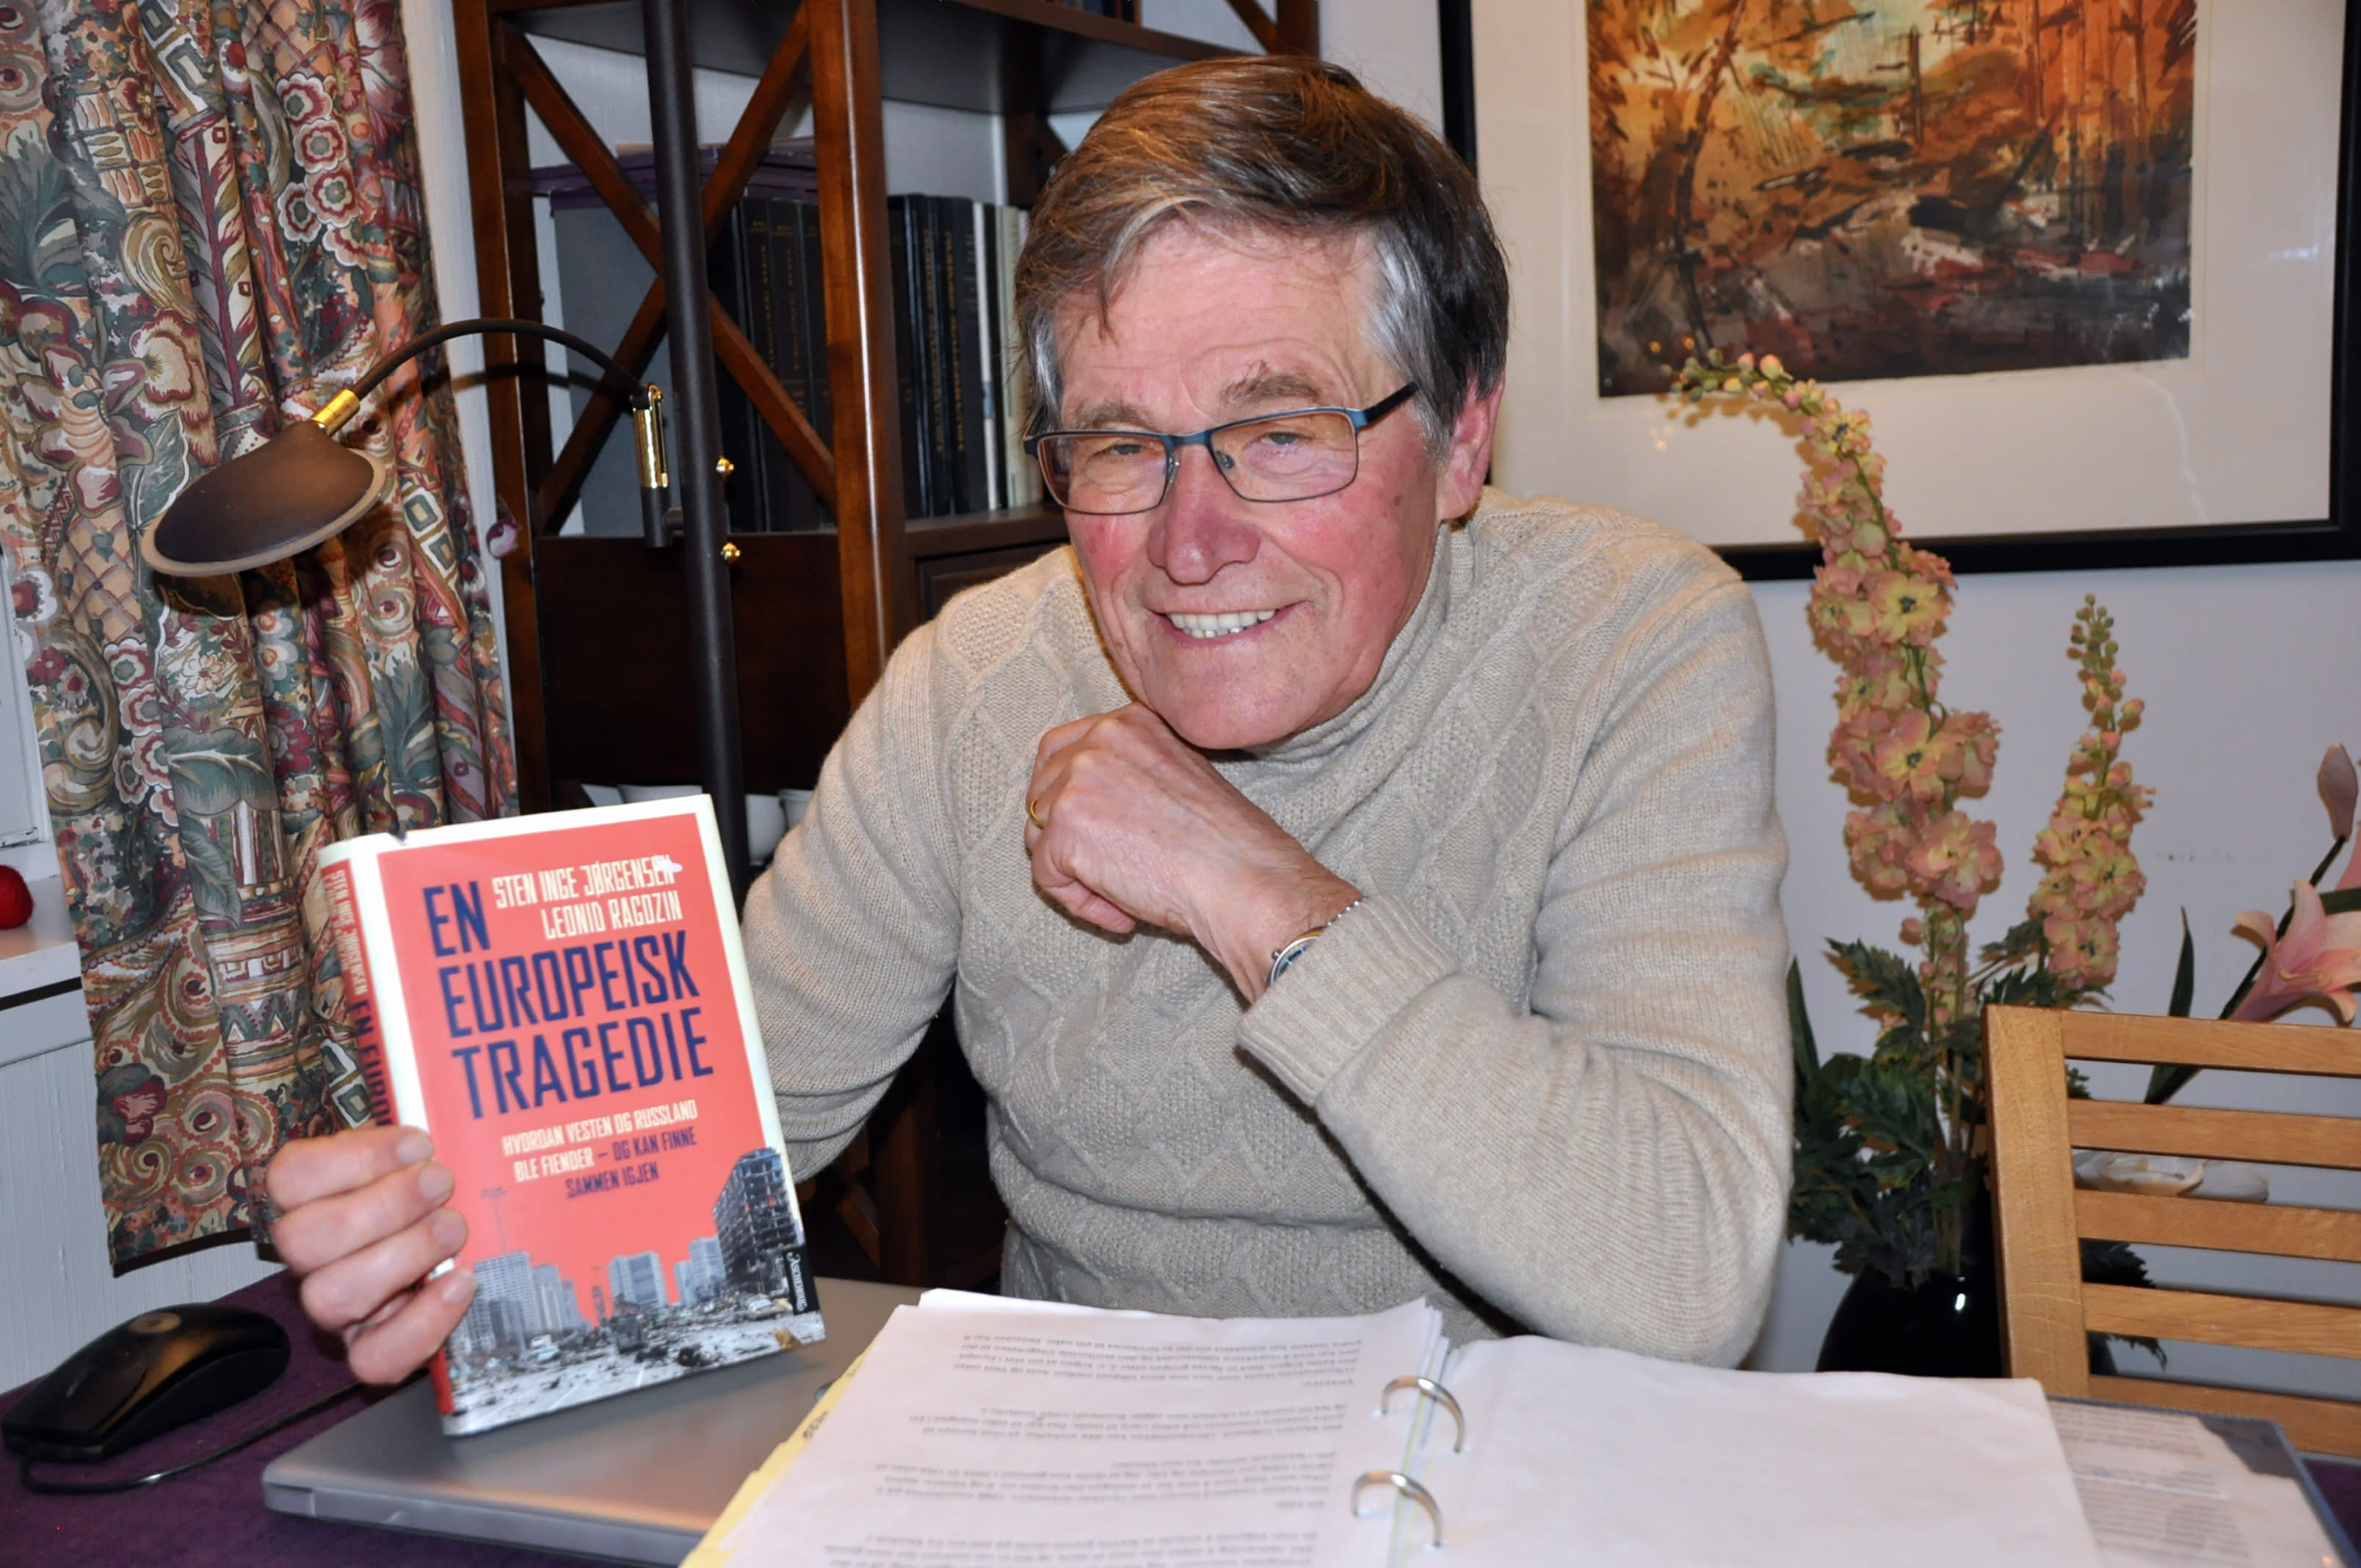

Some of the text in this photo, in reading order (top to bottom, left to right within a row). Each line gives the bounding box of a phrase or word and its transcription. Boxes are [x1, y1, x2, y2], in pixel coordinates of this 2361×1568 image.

[491, 854, 675, 909] STEN INGE JØRGENSEN
[423, 881, 490, 957] EN
[541, 890, 683, 940] LEONID RAGOZIN
[439, 930, 700, 1038] EUROPEISK
[451, 1007, 714, 1119] TRAGEDIE
[501, 1100, 698, 1156] HVORDAN VESTEN OG RUSSLAND
[514, 1158, 540, 1183] BLE
[541, 1147, 595, 1176] FIENDER
[612, 1139, 631, 1161] OG
[634, 1133, 659, 1156] KAN
[661, 1126, 697, 1151] FINNE
[565, 1161, 660, 1199] SAMMEN IGJEN
